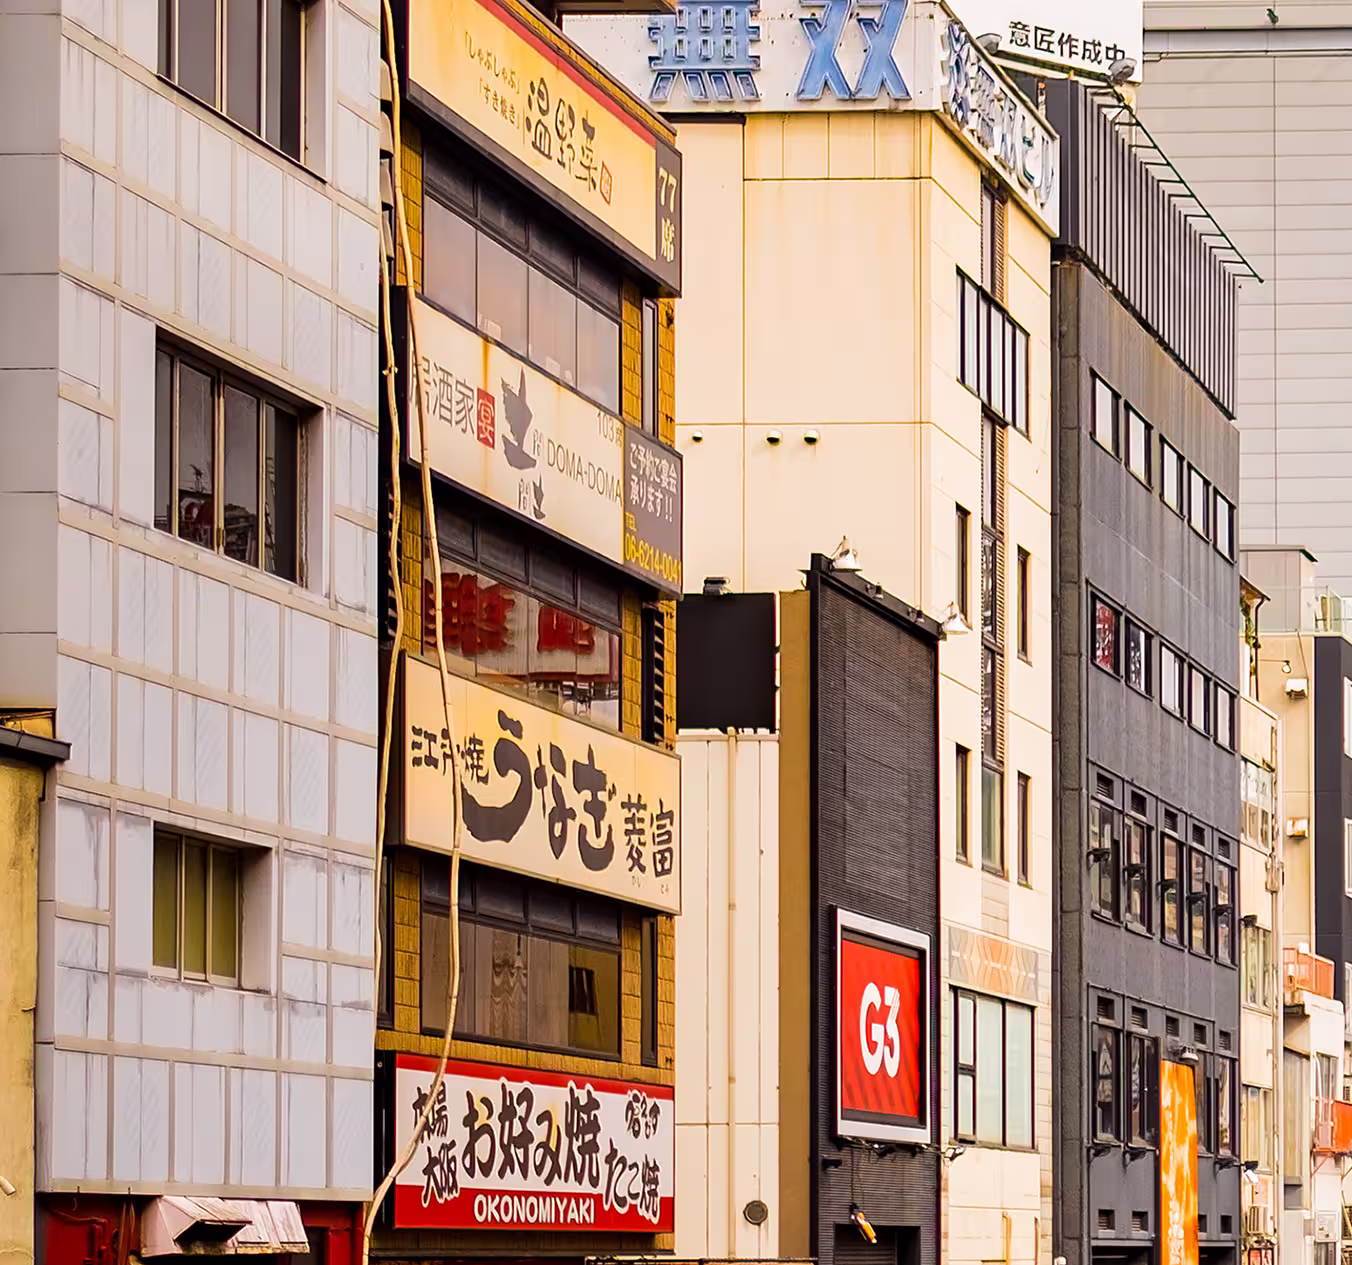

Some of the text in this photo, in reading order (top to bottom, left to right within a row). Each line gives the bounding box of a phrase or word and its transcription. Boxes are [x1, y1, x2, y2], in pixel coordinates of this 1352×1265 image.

[1009, 21, 1125, 64] 意匠作成中
[547, 439, 623, 506] DOMA-DOMA
[461, 709, 618, 872] うなぎ
[860, 982, 900, 1077] G3
[423, 1140, 459, 1206] 大阪
[461, 1081, 601, 1190] お好み焼
[474, 1193, 595, 1224] OKONOMIYAKI
[604, 1136, 660, 1223] たこ焼
